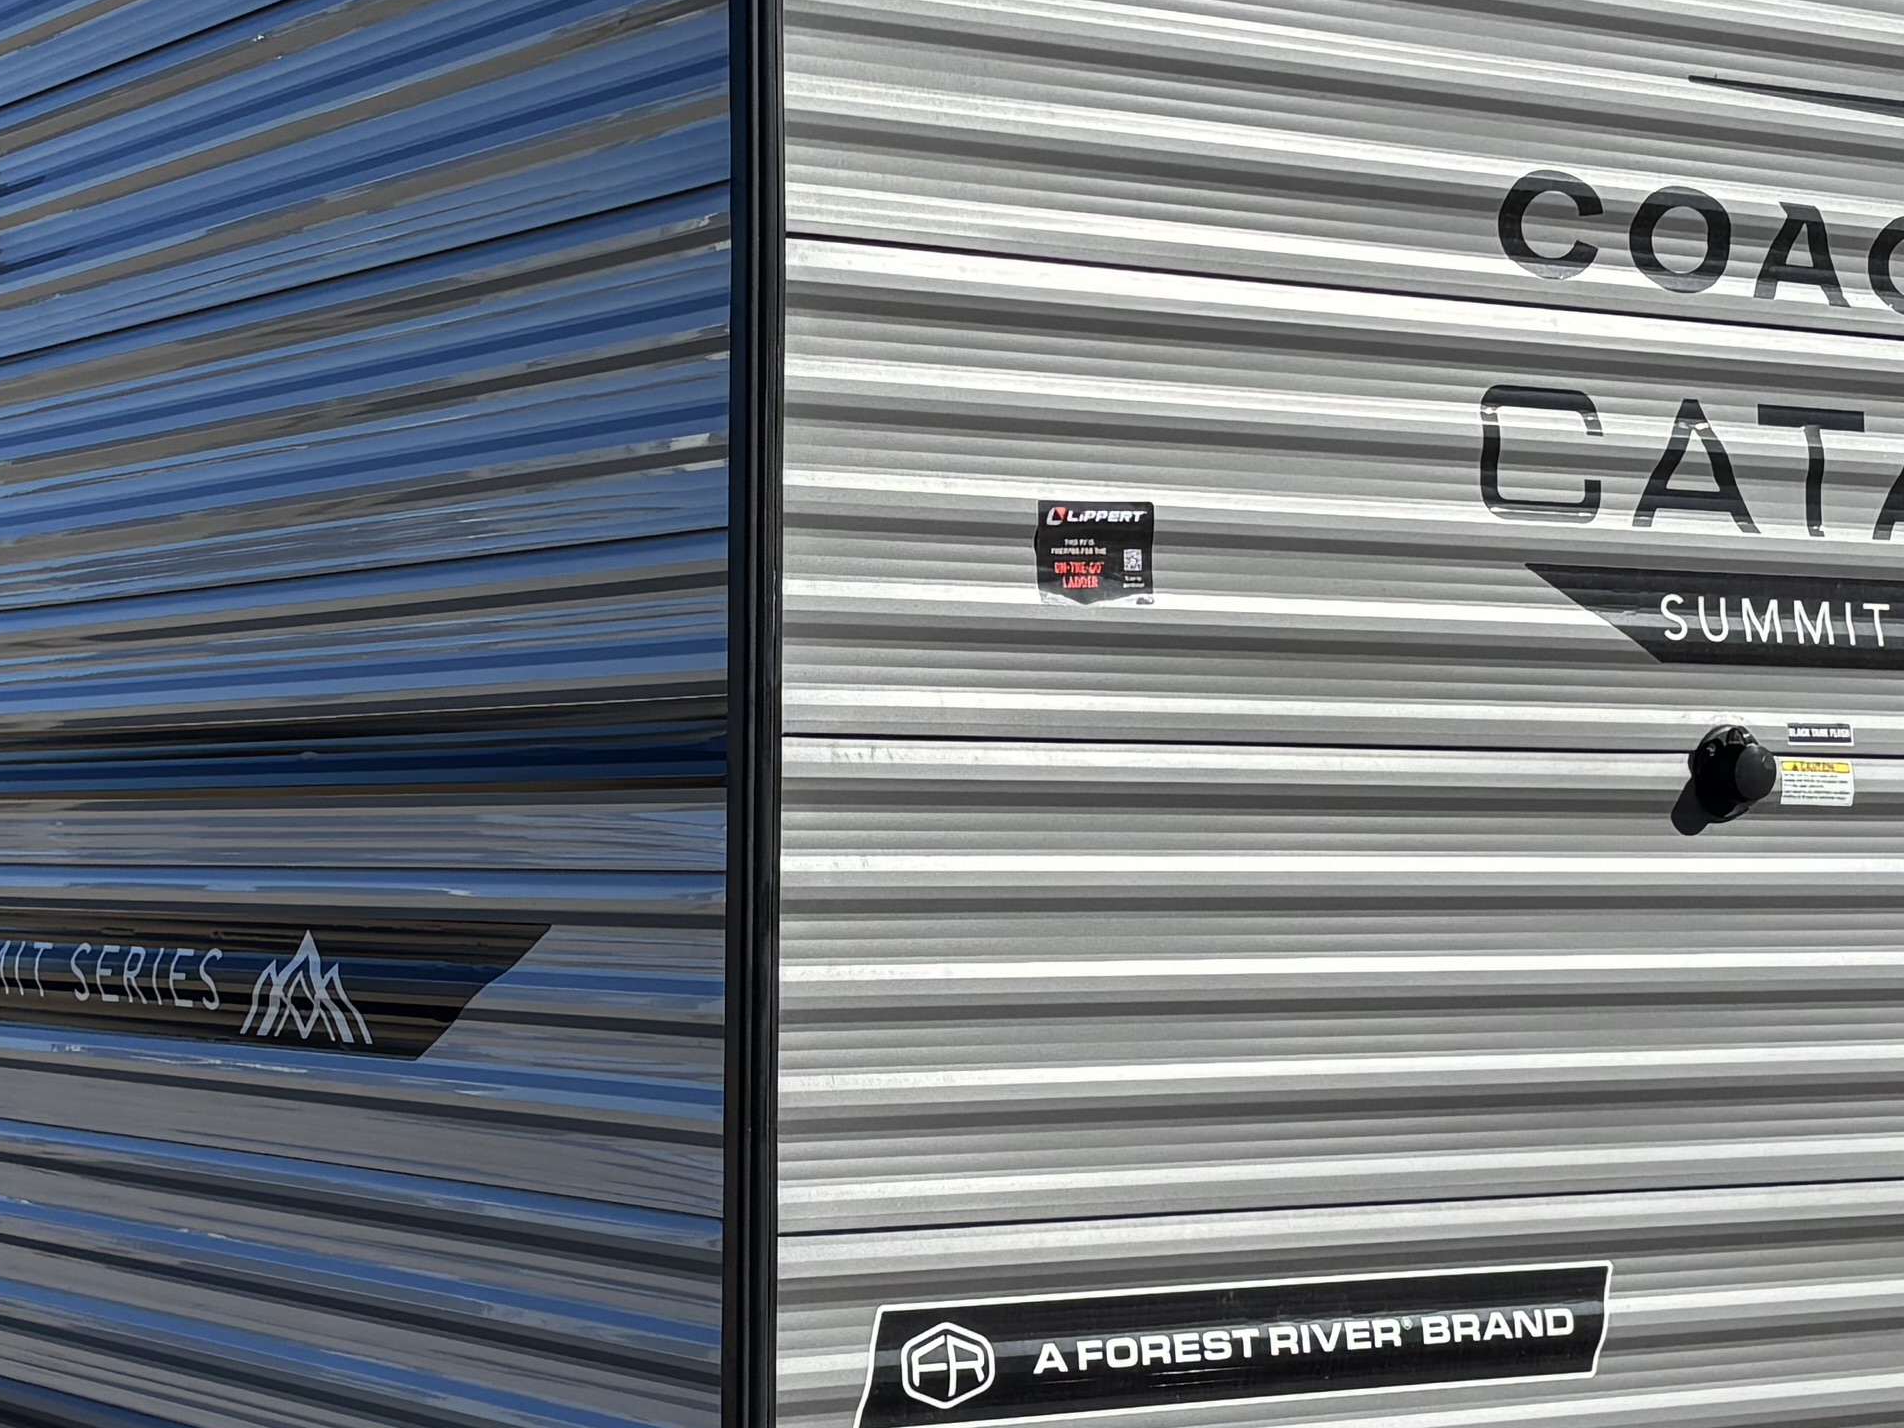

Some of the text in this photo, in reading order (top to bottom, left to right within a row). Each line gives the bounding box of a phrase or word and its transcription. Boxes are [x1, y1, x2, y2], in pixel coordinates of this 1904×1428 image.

[1659, 594, 1891, 649] SUMMIT
[70, 942, 224, 1011] SERIES
[1033, 1342, 1069, 1375] A
[1079, 1329, 1262, 1372] FOREST
[1422, 1307, 1576, 1346] BRAND
